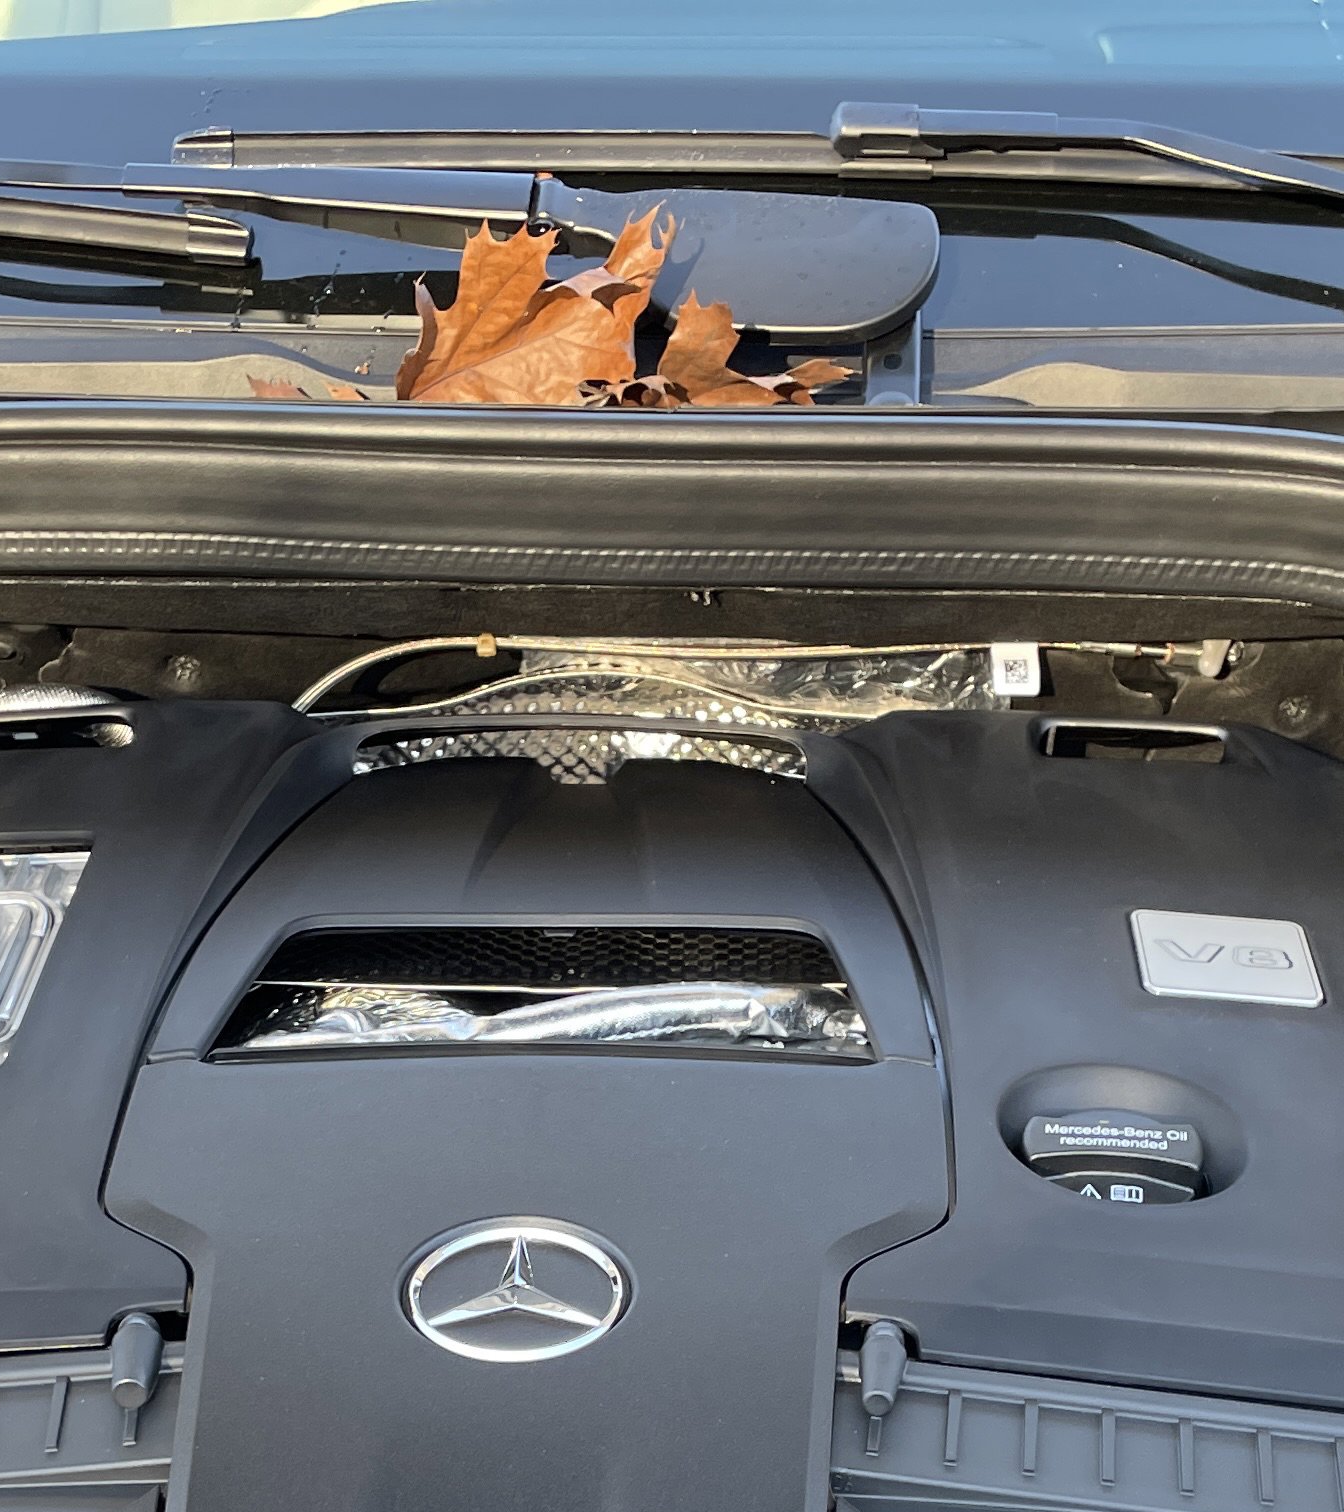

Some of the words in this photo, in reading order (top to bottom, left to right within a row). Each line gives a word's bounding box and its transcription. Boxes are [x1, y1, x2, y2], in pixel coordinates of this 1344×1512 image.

[1154, 938, 1294, 969] V8
[1044, 1123, 1163, 1140] Mercedes-Benz
[1166, 1129, 1188, 1141] Oil
[1059, 1135, 1168, 1150] recommended
